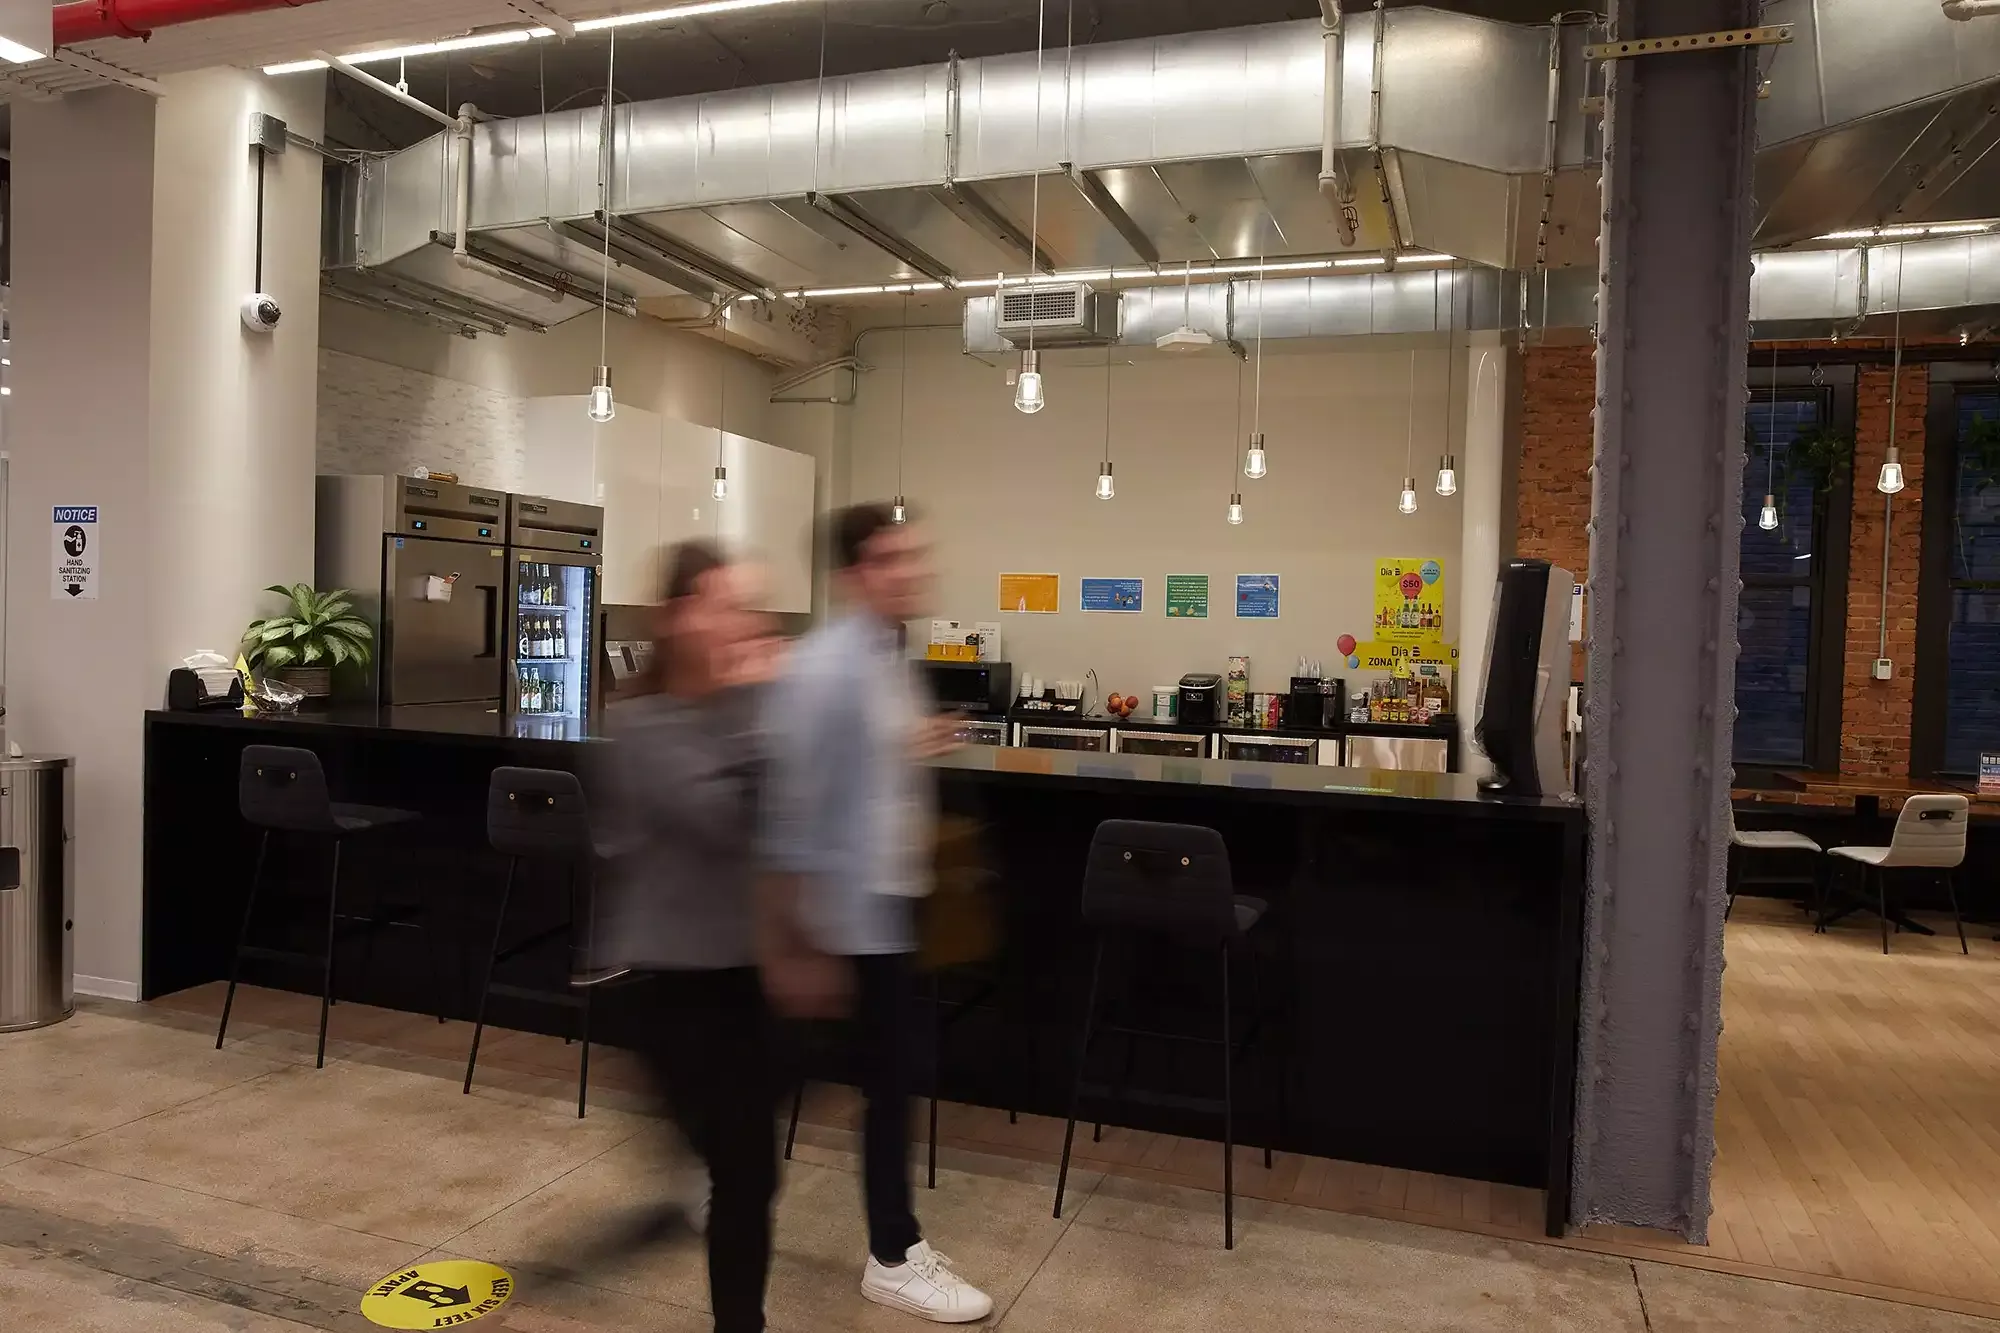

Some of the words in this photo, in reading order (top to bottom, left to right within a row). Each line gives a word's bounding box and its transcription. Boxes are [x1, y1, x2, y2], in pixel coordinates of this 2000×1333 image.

[55, 509, 96, 521] NOTICE
[1402, 579, 1420, 588] $50
[1391, 645, 1408, 657] Día
[1368, 657, 1393, 667] ZONA
[372, 1270, 420, 1298] APART
[491, 1277, 509, 1298] KEEP
[471, 1298, 500, 1314] SIX
[433, 1311, 473, 1327] FEET
